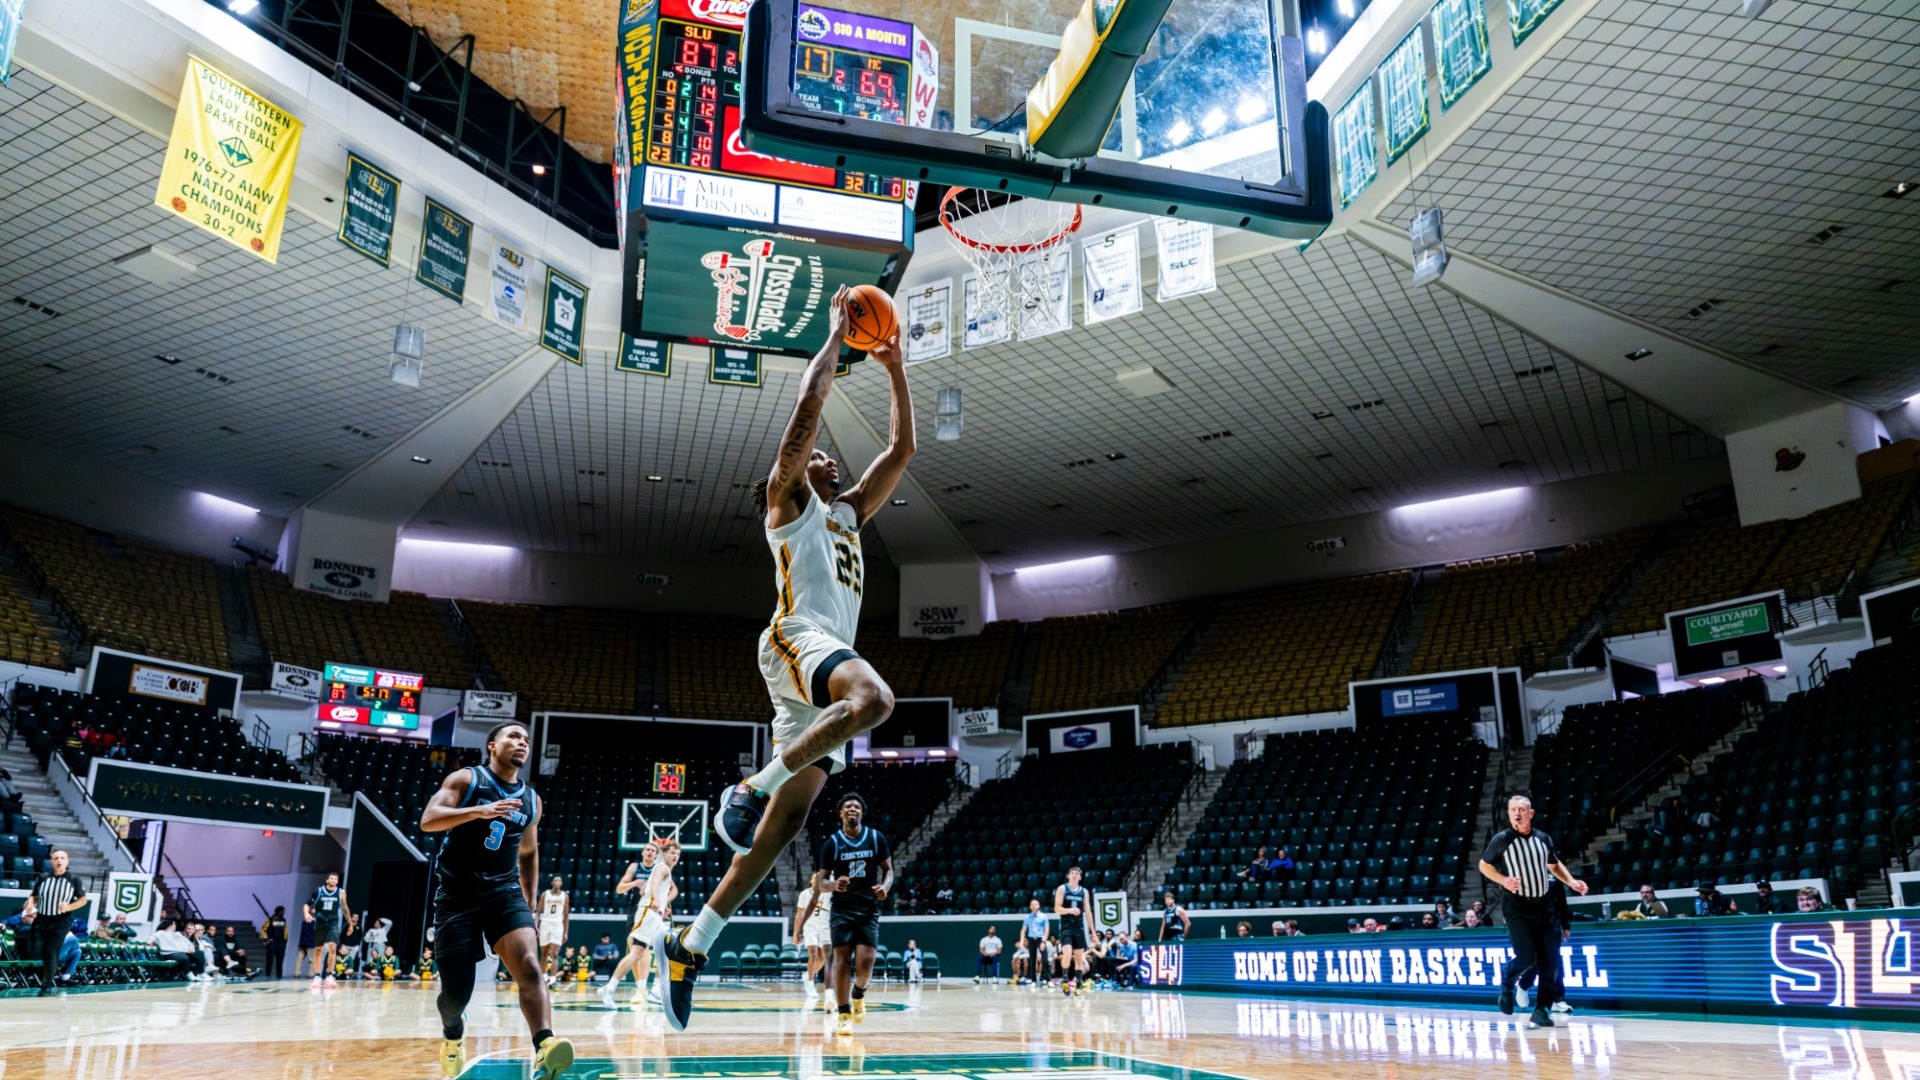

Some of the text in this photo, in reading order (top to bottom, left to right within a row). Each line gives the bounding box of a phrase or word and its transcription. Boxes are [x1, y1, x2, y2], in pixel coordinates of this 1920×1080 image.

[684, 26, 712, 40] SLU
[833, 22, 853, 36] $10
[854, 26, 863, 39] A
[866, 28, 906, 47] MONTH
[682, 40, 718, 68] 87
[726, 51, 737, 66] 2
[684, 67, 712, 77] BONUS
[723, 65, 738, 74] TOL
[867, 58, 882, 71] MC
[835, 69, 846, 85] 2
[861, 71, 893, 99] 69
[624, 23, 654, 166] SOUTHEASTERN
[666, 79, 717, 100] 0 2 14
[798, 93, 819, 103] TEAM
[832, 84, 846, 92] TOL
[202, 68, 292, 129] SOUTHEASTERN
[665, 96, 676, 111] 3
[701, 103, 715, 117] 12
[835, 100, 843, 113] 7
[856, 96, 881, 106] BONUS
[210, 89, 279, 137] LADY LIONS
[663, 113, 714, 133] 5 4 7
[205, 103, 276, 152] BASKETBALL
[662, 130, 672, 144] 8
[697, 136, 712, 151] 10
[651, 146, 671, 162] 23
[690, 152, 711, 167] 20
[184, 147, 275, 204] 1976-77 AIAW
[192, 171, 259, 215] NATIONAL
[845, 175, 864, 191] 32
[891, 184, 901, 197] 0
[181, 184, 263, 234] CHAMPIONS
[348, 194, 392, 223] Basketball
[353, 187, 390, 214] Women's
[203, 213, 236, 238] 30-2
[427, 238, 466, 264] Basketball
[431, 232, 463, 256] Women's
[1104, 235, 1116, 248] S
[499, 246, 524, 269] SLU
[1170, 257, 1198, 270] SLC
[492, 270, 526, 291] Basketball
[496, 264, 525, 284] Women's
[755, 254, 803, 333] Crossroads
[784, 255, 824, 338] TANGIPAHOA PARISH
[924, 287, 934, 298] S
[560, 308, 570, 320] 21
[641, 356, 660, 364] CORE
[1307, 540, 1337, 552] Gate
[313, 558, 376, 579] RONNIE'S
[835, 541, 862, 598] 23
[637, 574, 674, 586] Gate 2
[309, 583, 335, 594] Boudin
[344, 588, 373, 599] Cracklin
[920, 606, 958, 621] S&W
[1690, 608, 1758, 628] COURTYARD
[922, 626, 955, 635] FOODS
[1710, 620, 1744, 634] Marriott
[279, 664, 319, 681] RONNIE'S
[331, 686, 415, 708] 87 5:17 69
[374, 700, 382, 710] 2
[470, 691, 513, 702] RONNIE'S
[964, 712, 989, 725] S&W
[966, 727, 988, 735] FOODS
[658, 775, 680, 791] 28
[484, 820, 506, 851] 3
[841, 849, 874, 861] CHOCTAWS
[848, 860, 867, 878] 12
[121, 886, 138, 905] S
[1104, 903, 1118, 920] S
[1234, 950, 1288, 982] HOME
[1292, 950, 1319, 982] OF
[1323, 949, 1382, 983] LION
[1389, 945, 1609, 988] BASKETLL
